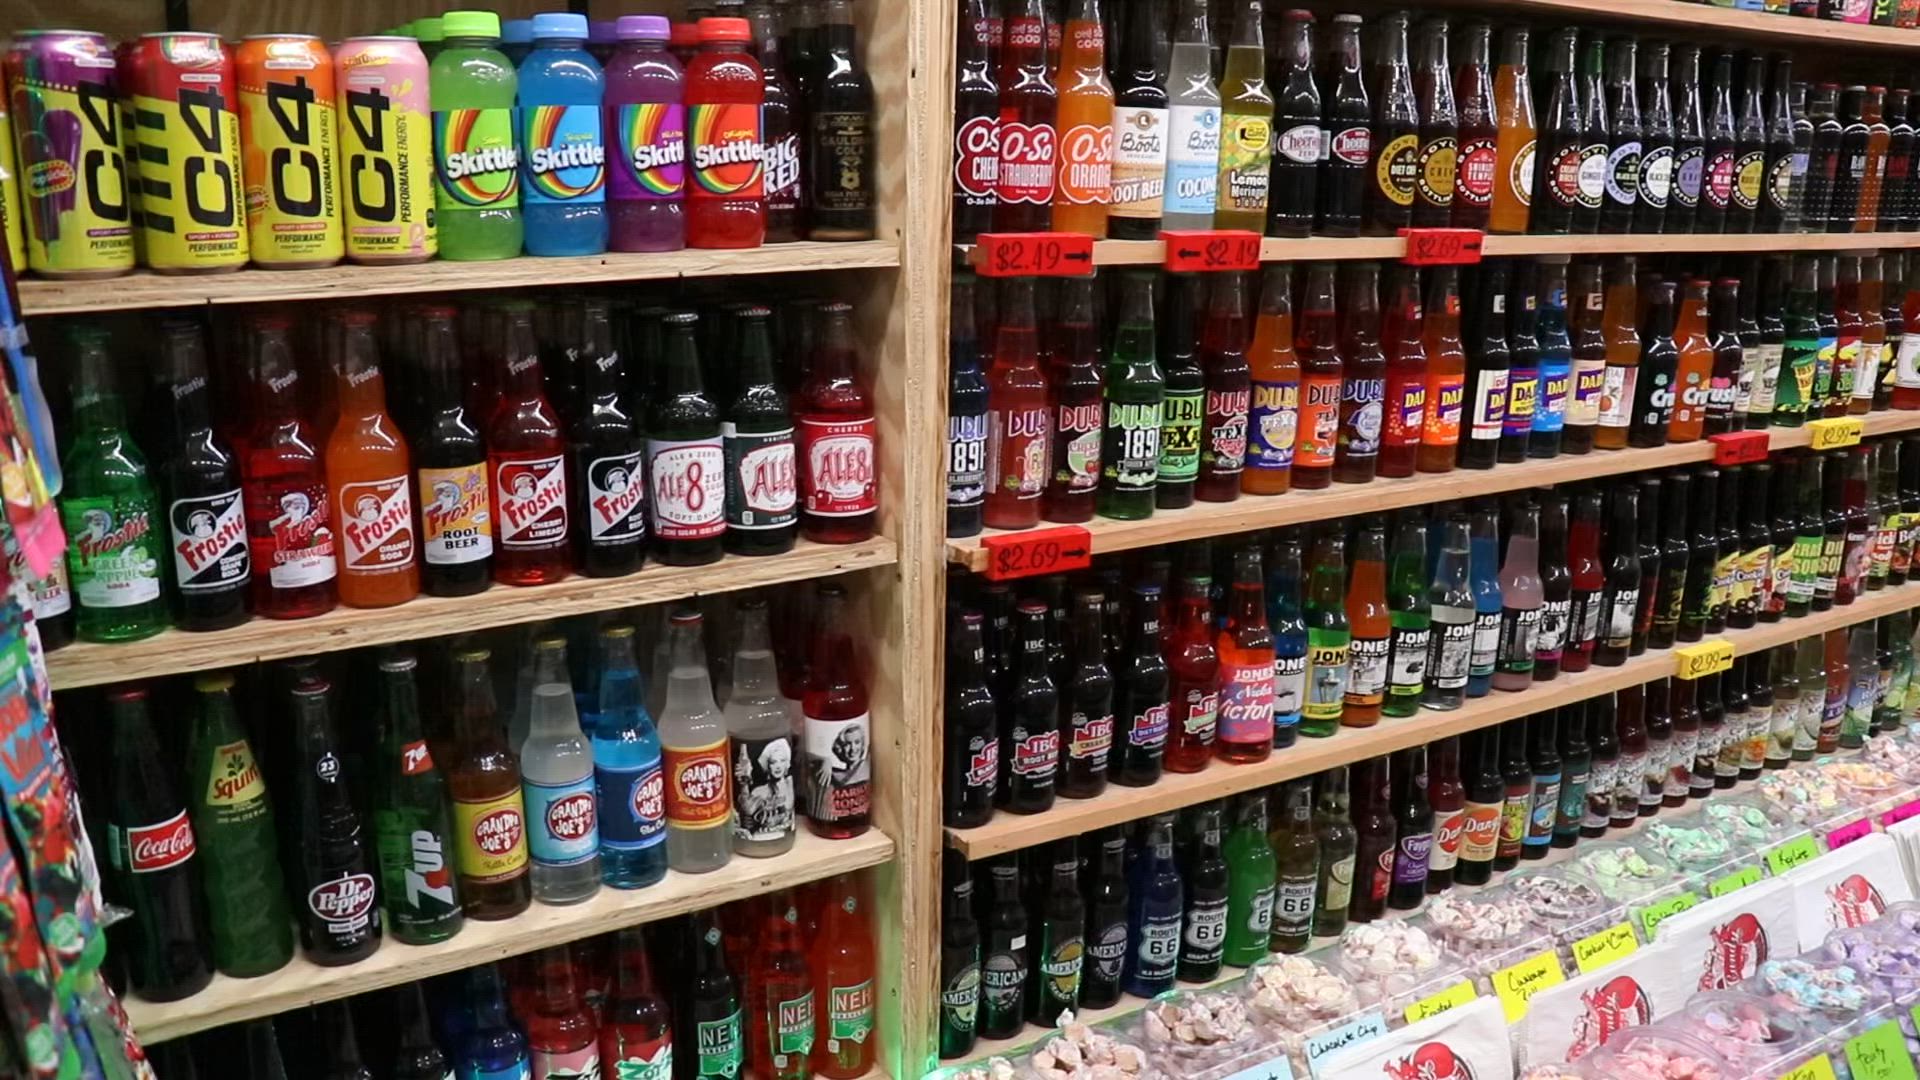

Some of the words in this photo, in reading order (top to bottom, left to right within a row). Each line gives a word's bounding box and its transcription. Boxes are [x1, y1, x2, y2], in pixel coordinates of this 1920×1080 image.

[394, 115, 407, 151] ENERGY
[1120, 132, 1160, 153] Boots
[179, 86, 234, 227] C4
[267, 76, 321, 217] C4
[346, 87, 396, 222] C4
[764, 135, 797, 172] BIG
[1002, 132, 1053, 161] O-So
[447, 146, 522, 178] Skittle
[321, 147, 334, 217] PERFORMANCE
[763, 157, 800, 196] RED
[399, 152, 411, 223] PERFORMANCE
[995, 240, 1061, 271] $2.49
[1204, 238, 1260, 267] $2.49
[827, 425, 863, 433] CHERRY
[659, 472, 685, 501] ALE
[687, 462, 704, 511] 8
[443, 527, 478, 539] ROOT
[445, 538, 478, 549] BEER
[380, 551, 403, 561] SODA
[998, 542, 1060, 575] $2.69
[1025, 639, 1044, 650] IBC
[1687, 652, 1720, 676] $2.99
[1090, 721, 1115, 738] IBC
[1031, 738, 1058, 754] IBC
[321, 761, 336, 771] 23
[685, 780, 713, 799] JOE'S
[556, 816, 584, 836] JOE'S
[481, 830, 511, 851] JOE'S
[404, 830, 454, 909] 7UP
[338, 880, 363, 899] Dr
[1285, 886, 1313, 896] ROUTE
[318, 889, 372, 916] Pepper
[1283, 897, 1311, 912] 66
[1197, 922, 1223, 940] 66
[1150, 938, 1177, 954] 66
[1358, 1025, 1378, 1038] Chip
